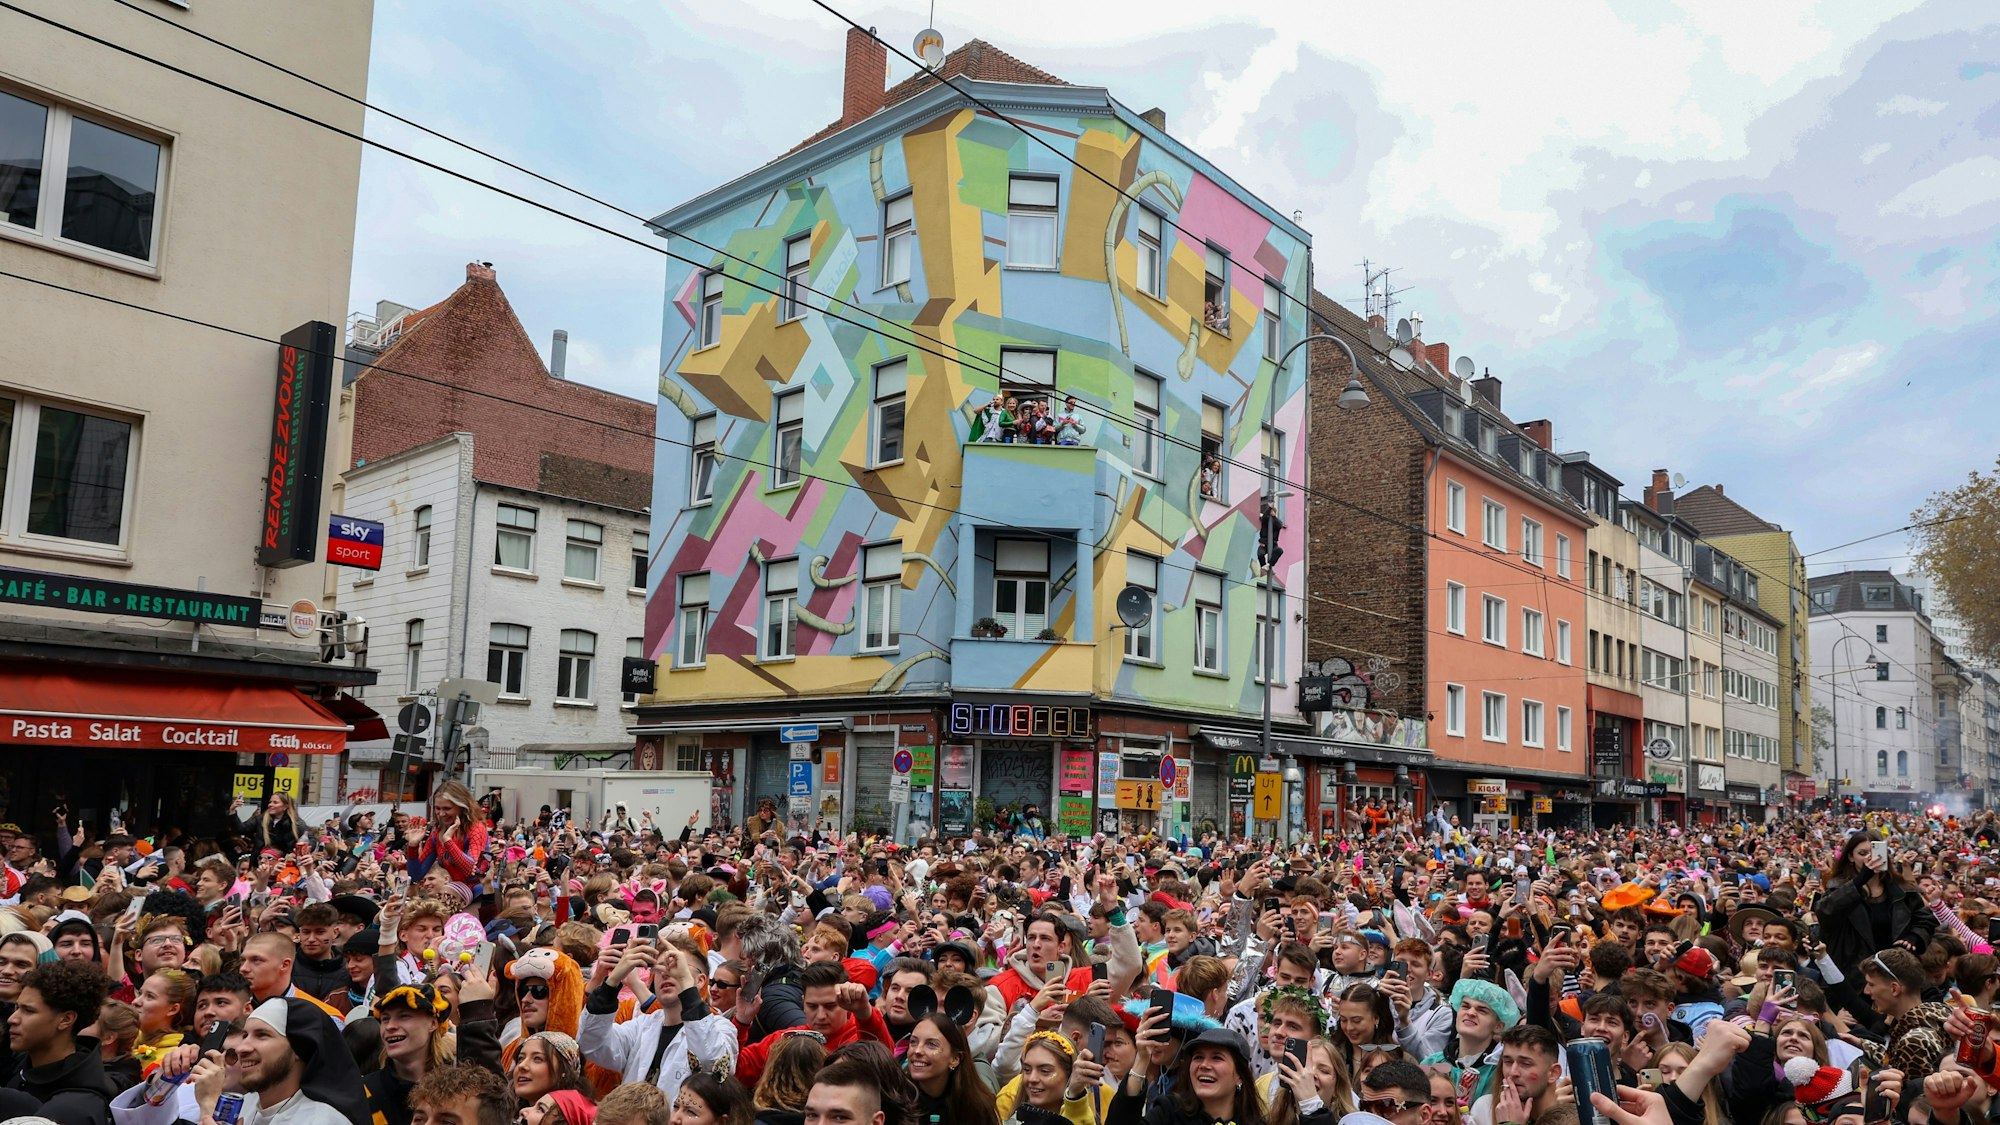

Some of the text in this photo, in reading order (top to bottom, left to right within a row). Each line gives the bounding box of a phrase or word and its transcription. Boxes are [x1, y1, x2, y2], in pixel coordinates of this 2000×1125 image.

[265, 345, 296, 549] RENDEZVOUS
[281, 353, 305, 536] CAFÉ BAR RESTAURANT
[340, 522, 370, 541] sky
[335, 544, 370, 561] sport
[66, 586, 107, 608] BAR
[126, 593, 250, 622] RESTAURANT
[955, 707, 1086, 734] STIEFEL
[12, 719, 332, 750] Pasta Salat Cocktail früh KÖLSCH
[793, 764, 803, 777] P
[1262, 778, 1274, 789] U1
[1478, 785, 1501, 793] KIOSK
[1650, 785, 1664, 794] sky
[655, 806, 660, 815] 3
